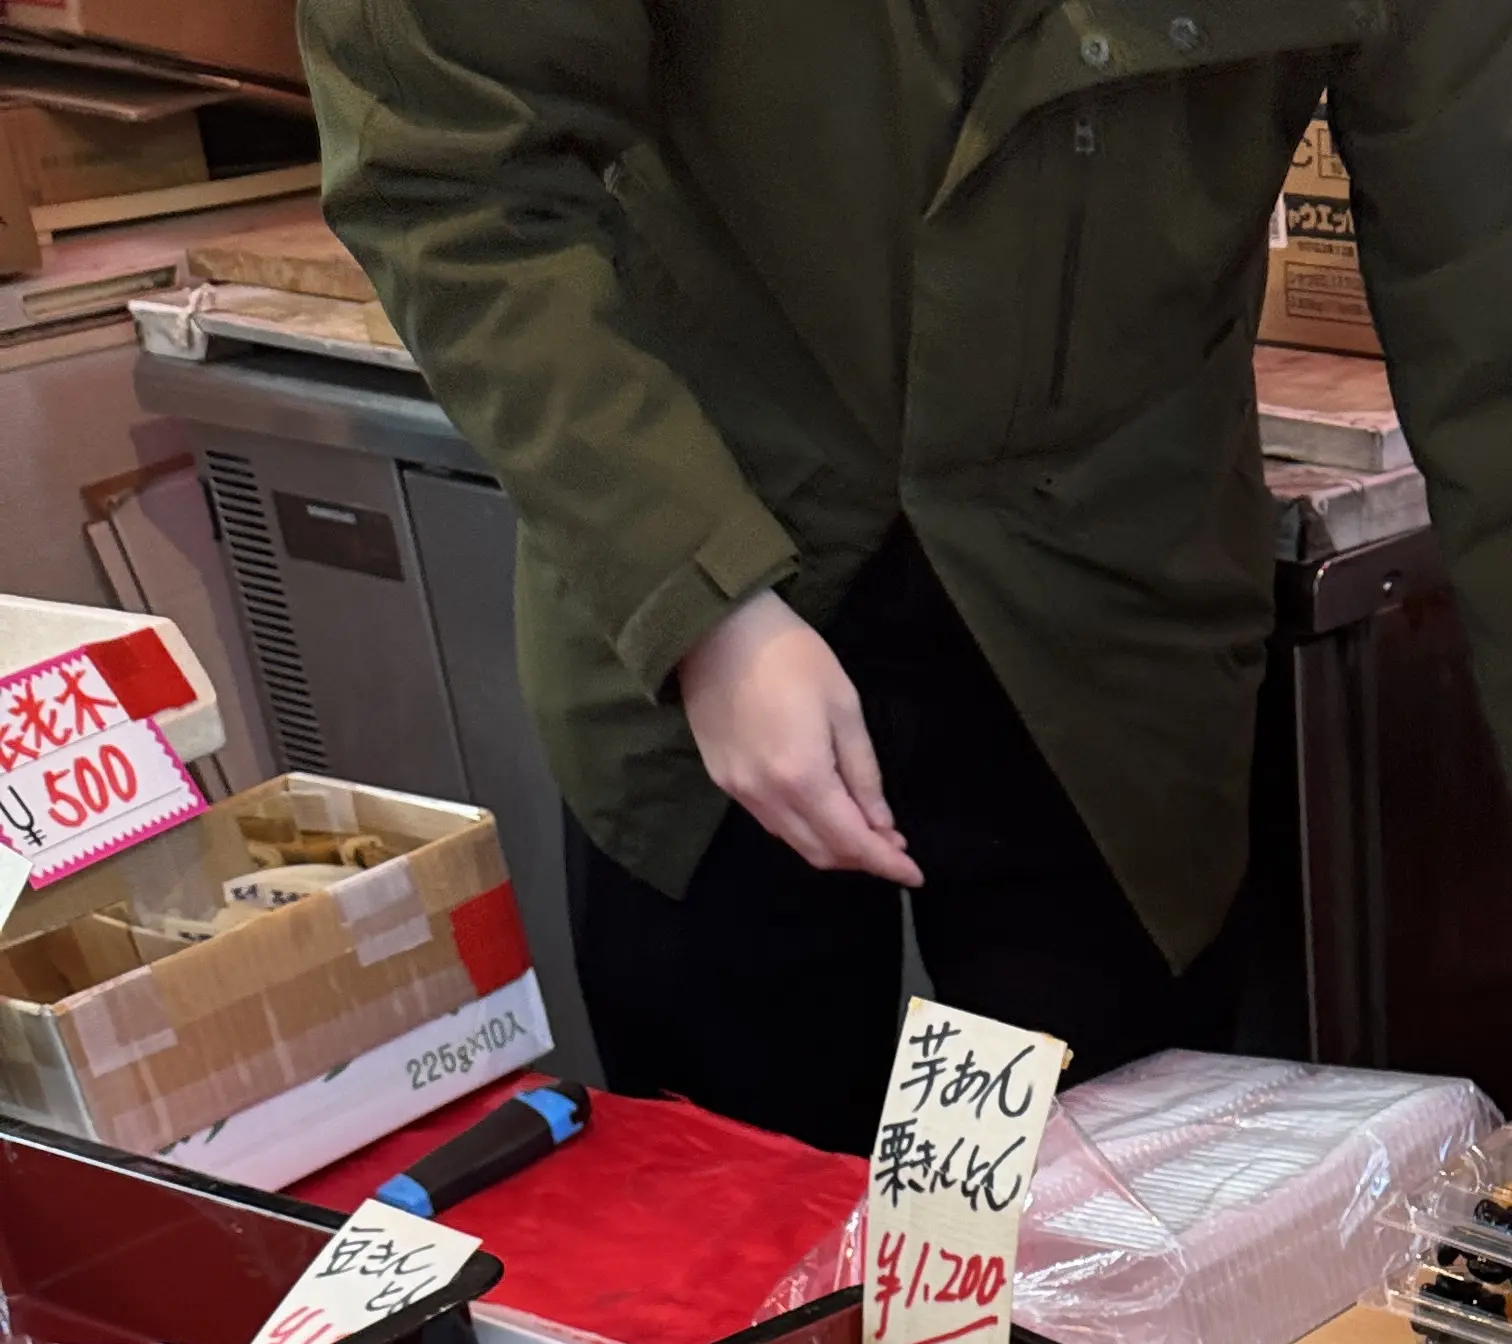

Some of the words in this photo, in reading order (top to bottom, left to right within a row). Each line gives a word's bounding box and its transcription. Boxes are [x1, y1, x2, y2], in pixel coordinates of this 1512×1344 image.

[900, 1020, 1037, 1119] 芋あん
[875, 1116, 1026, 1213] 栗きんとん
